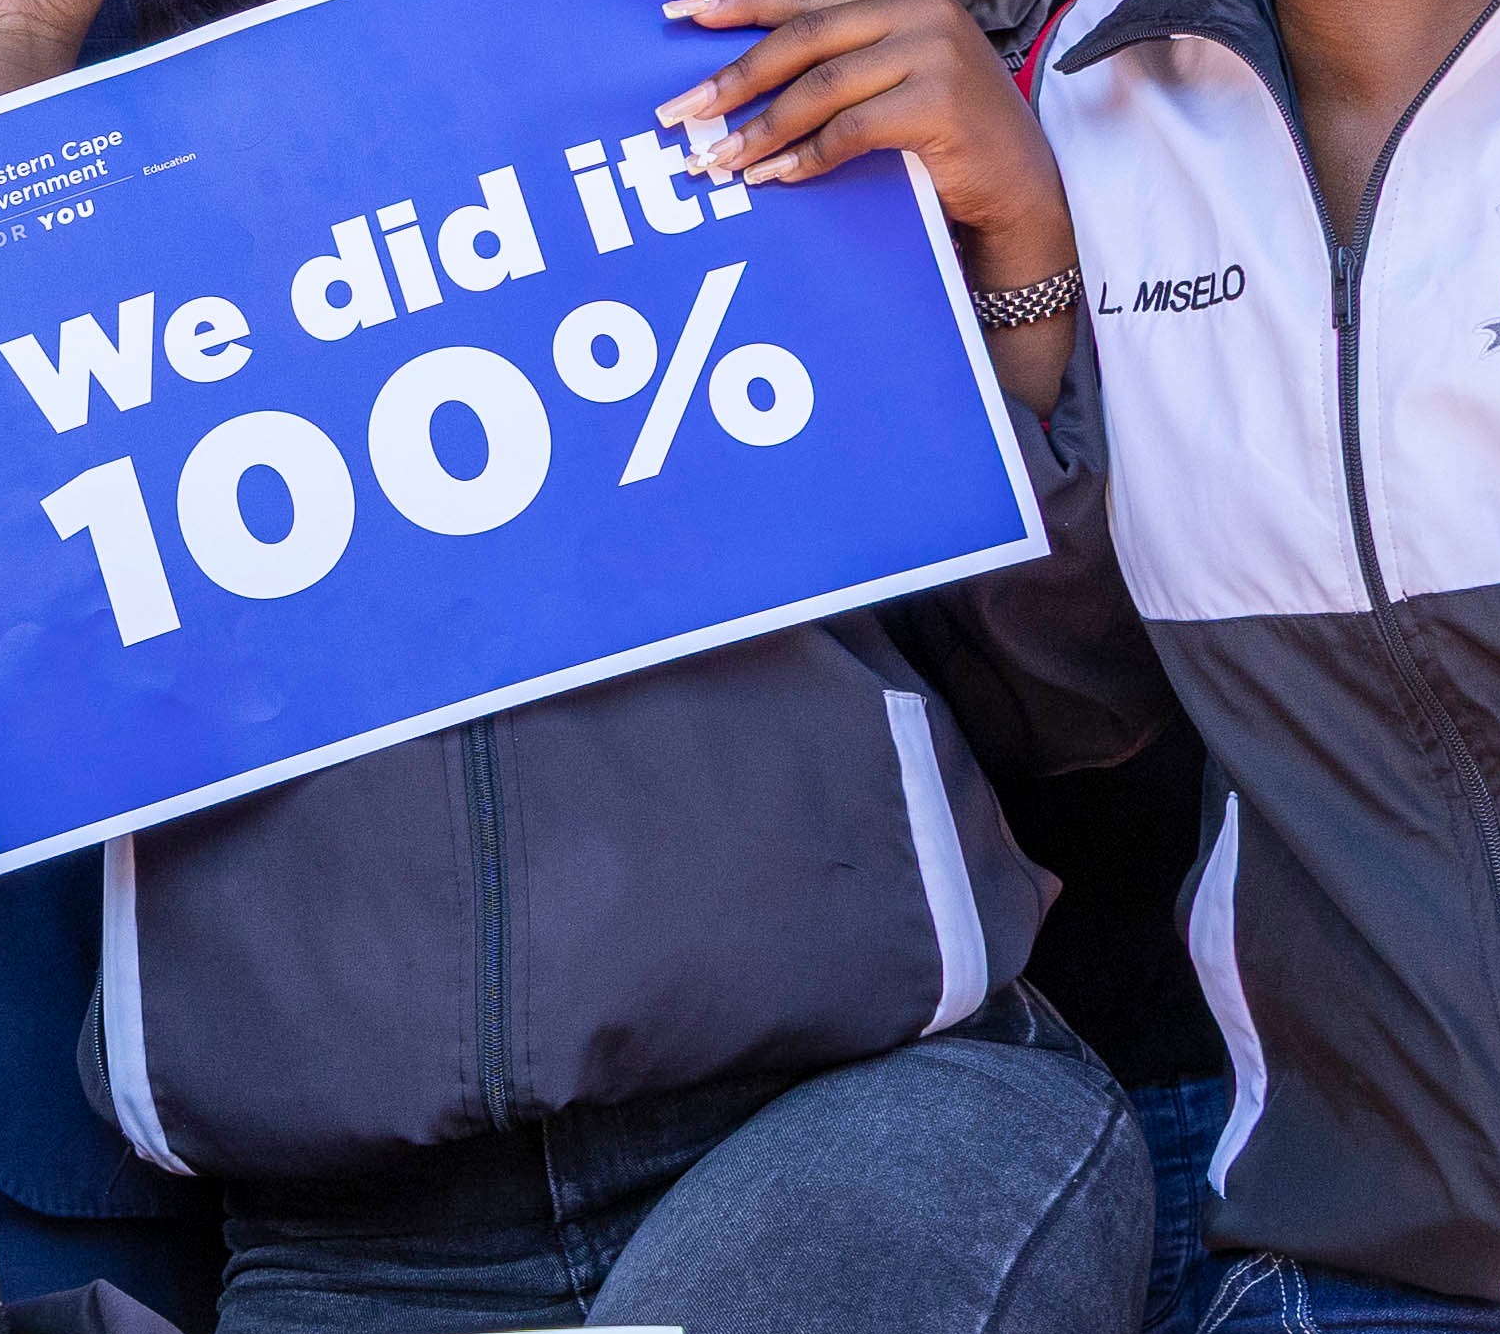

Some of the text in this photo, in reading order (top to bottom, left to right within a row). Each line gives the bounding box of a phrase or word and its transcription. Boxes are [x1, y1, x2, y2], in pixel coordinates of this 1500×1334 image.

[61, 129, 124, 161] Cape
[142, 152, 197, 176] Education
[37, 199, 96, 231] YOU
[0, 290, 252, 435] We
[290, 166, 547, 343] did
[1098, 264, 1246, 316] L. MISELO
[39, 260, 816, 649] 100%
